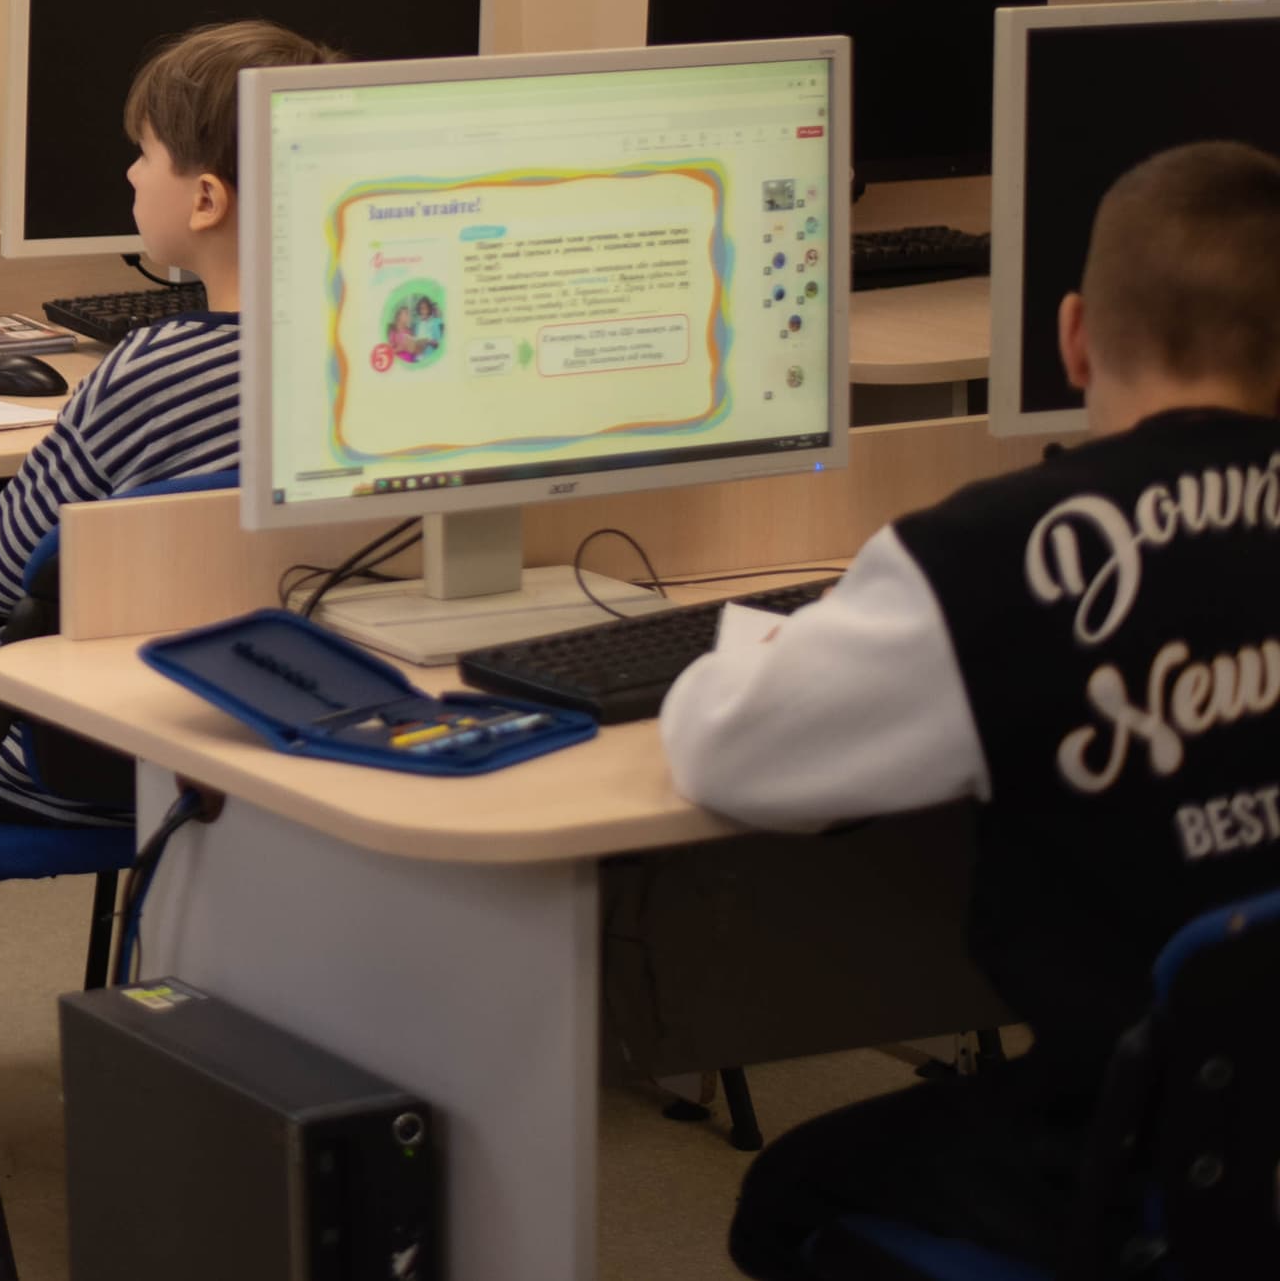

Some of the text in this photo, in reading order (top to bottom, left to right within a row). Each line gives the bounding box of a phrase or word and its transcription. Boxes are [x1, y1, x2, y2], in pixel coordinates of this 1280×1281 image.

[373, 347, 391, 369] 5
[1024, 452, 1280, 645] Down
[1057, 639, 1280, 793] New
[1176, 786, 1280, 860] BEST
